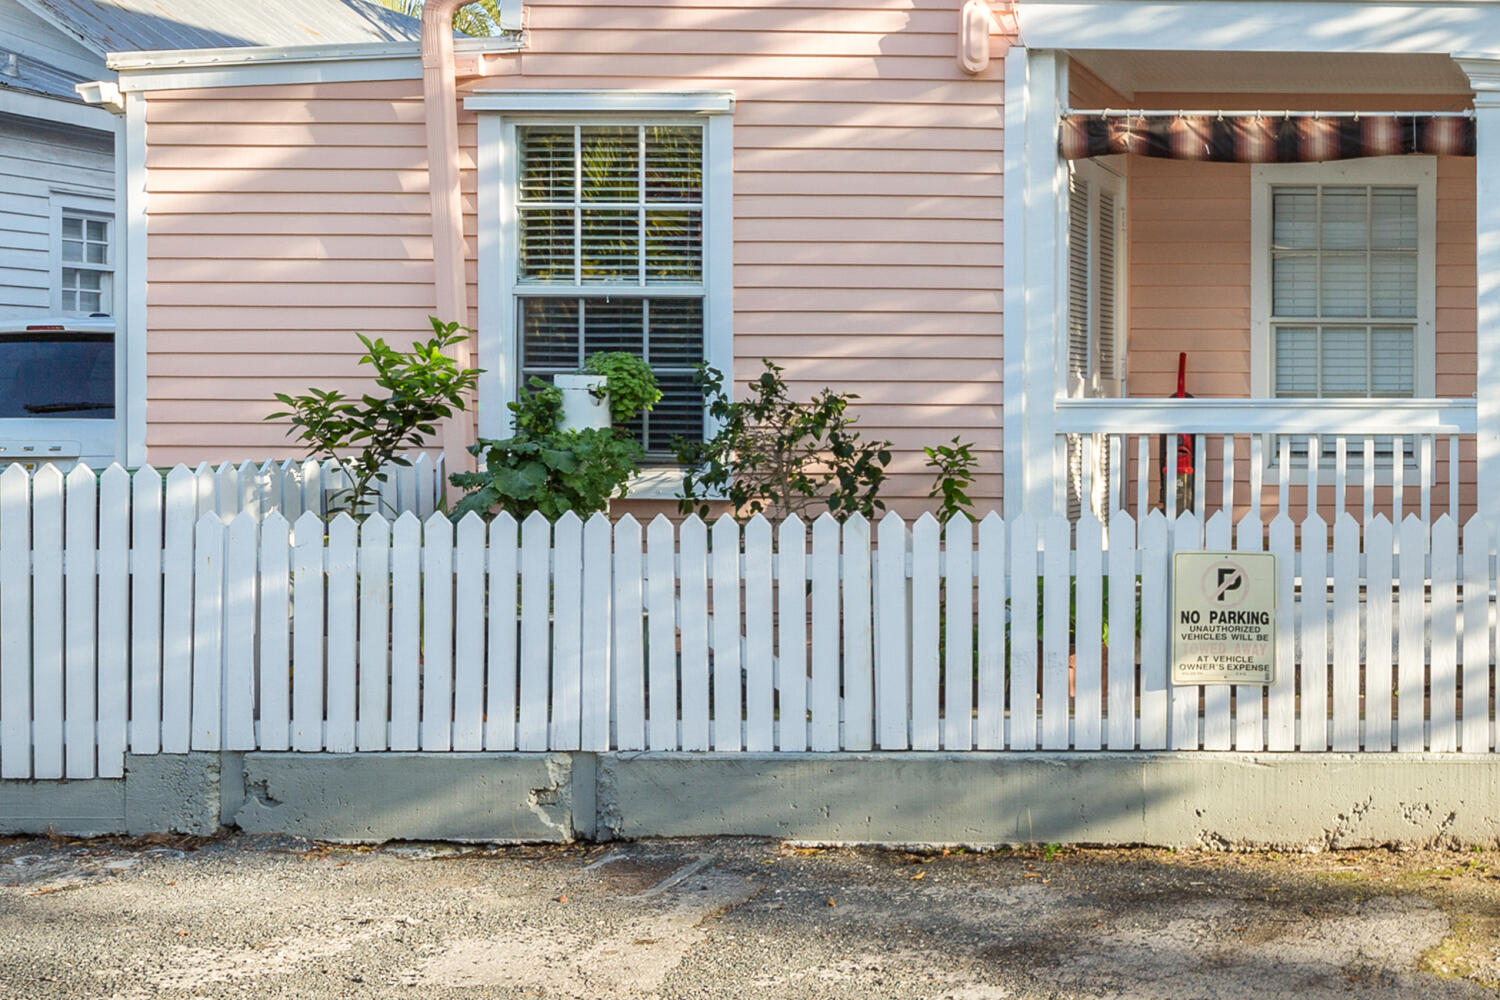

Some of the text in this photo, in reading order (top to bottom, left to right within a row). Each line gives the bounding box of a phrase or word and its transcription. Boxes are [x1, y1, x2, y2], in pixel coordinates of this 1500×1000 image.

[1180, 610, 1270, 625] NO PARKING
[1189, 625, 1261, 633] UNAUTHORIZED
[1181, 633, 1227, 641] VEHICLES
[1231, 633, 1253, 641] WILL
[1233, 643, 1268, 655] AWAY
[1213, 655, 1254, 663] VEHICLE
[1179, 663, 1270, 672] OWNER'S EXPENSE
